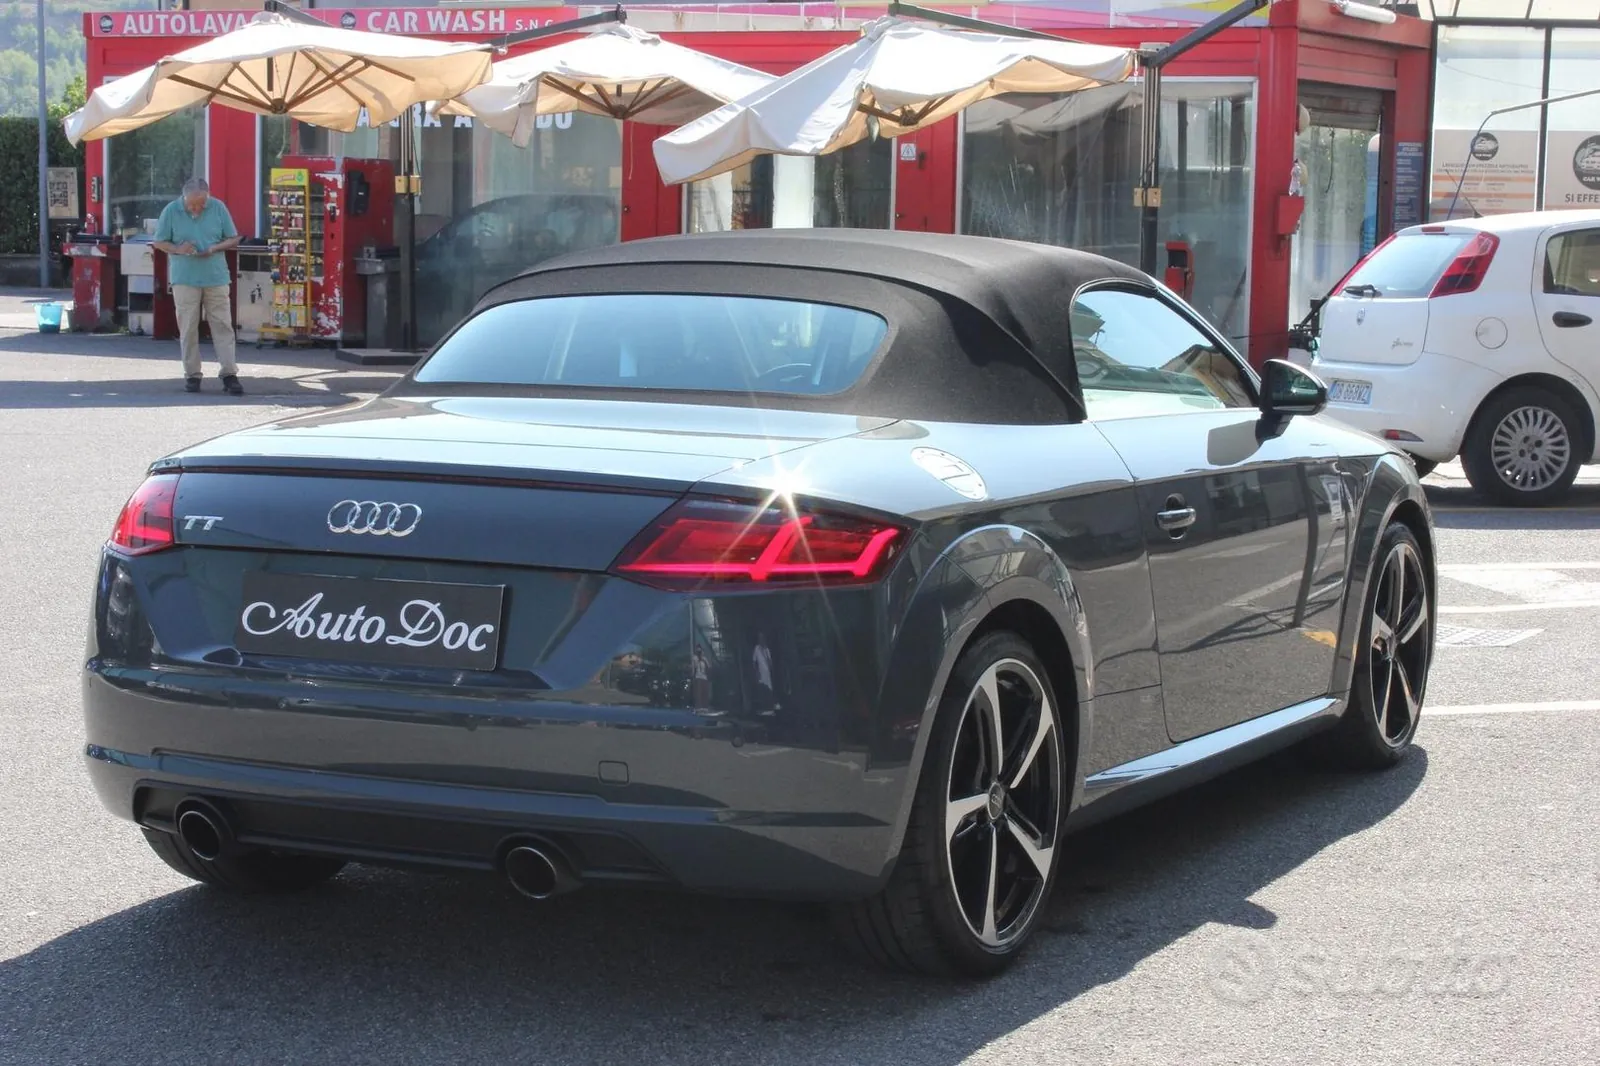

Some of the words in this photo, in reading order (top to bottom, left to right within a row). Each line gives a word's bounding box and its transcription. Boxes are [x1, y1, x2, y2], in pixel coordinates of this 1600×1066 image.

[122, 13, 257, 34] AUTOLAVA
[367, 11, 419, 33] CAR
[427, 9, 506, 33] WASH
[184, 515, 224, 531] TT
